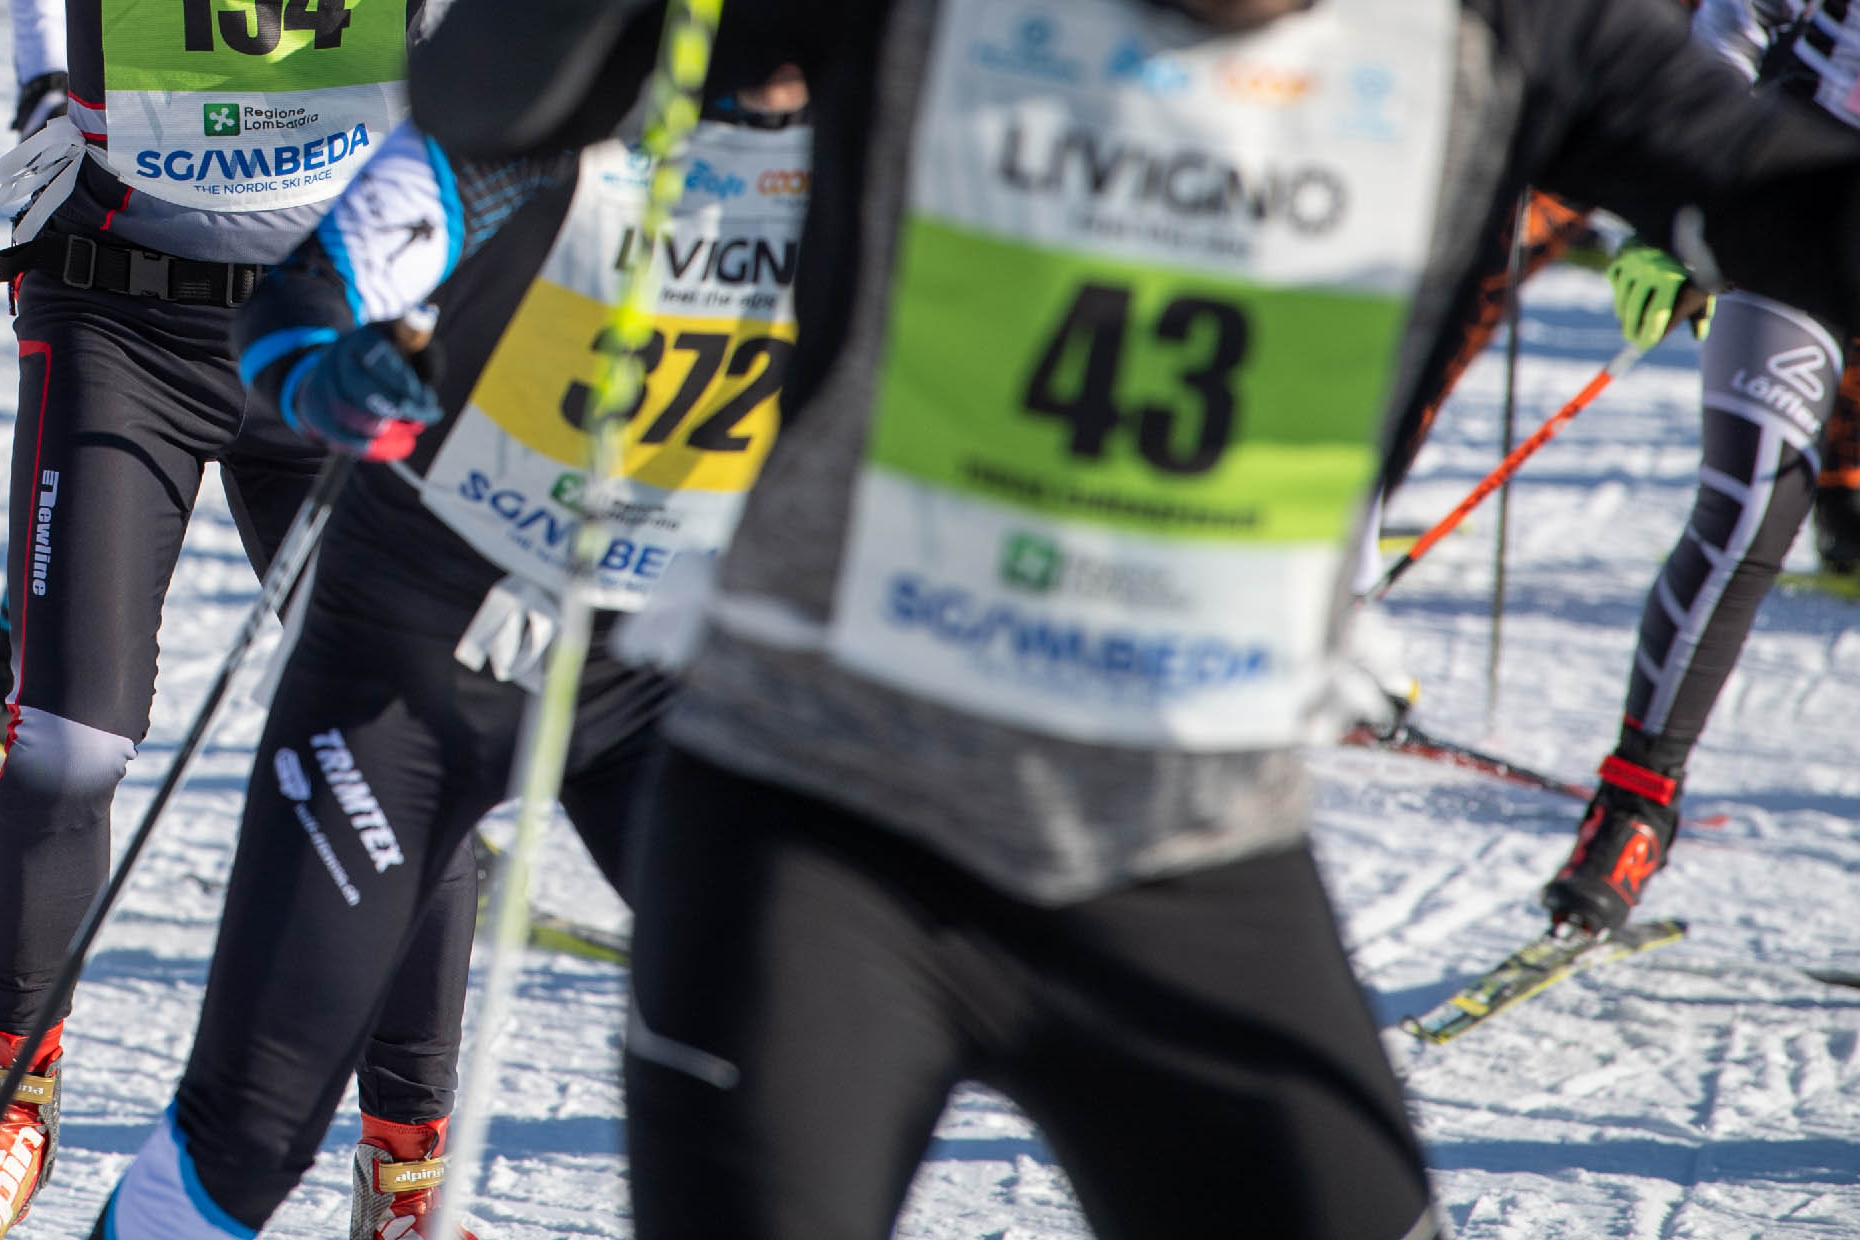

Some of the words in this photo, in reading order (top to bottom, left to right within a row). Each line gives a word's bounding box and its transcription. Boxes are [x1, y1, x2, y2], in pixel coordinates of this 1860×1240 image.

[244, 106, 306, 121] Regione
[244, 113, 319, 131] Lombardia
[193, 184, 221, 195] THE
[226, 182, 278, 195] NORDIC
[282, 177, 301, 190] SKI
[304, 168, 333, 186] RACE
[997, 122, 1352, 238] LIVIGNO
[615, 226, 797, 287] LVIGN
[560, 330, 797, 454] 372
[1022, 281, 1252, 478] 43
